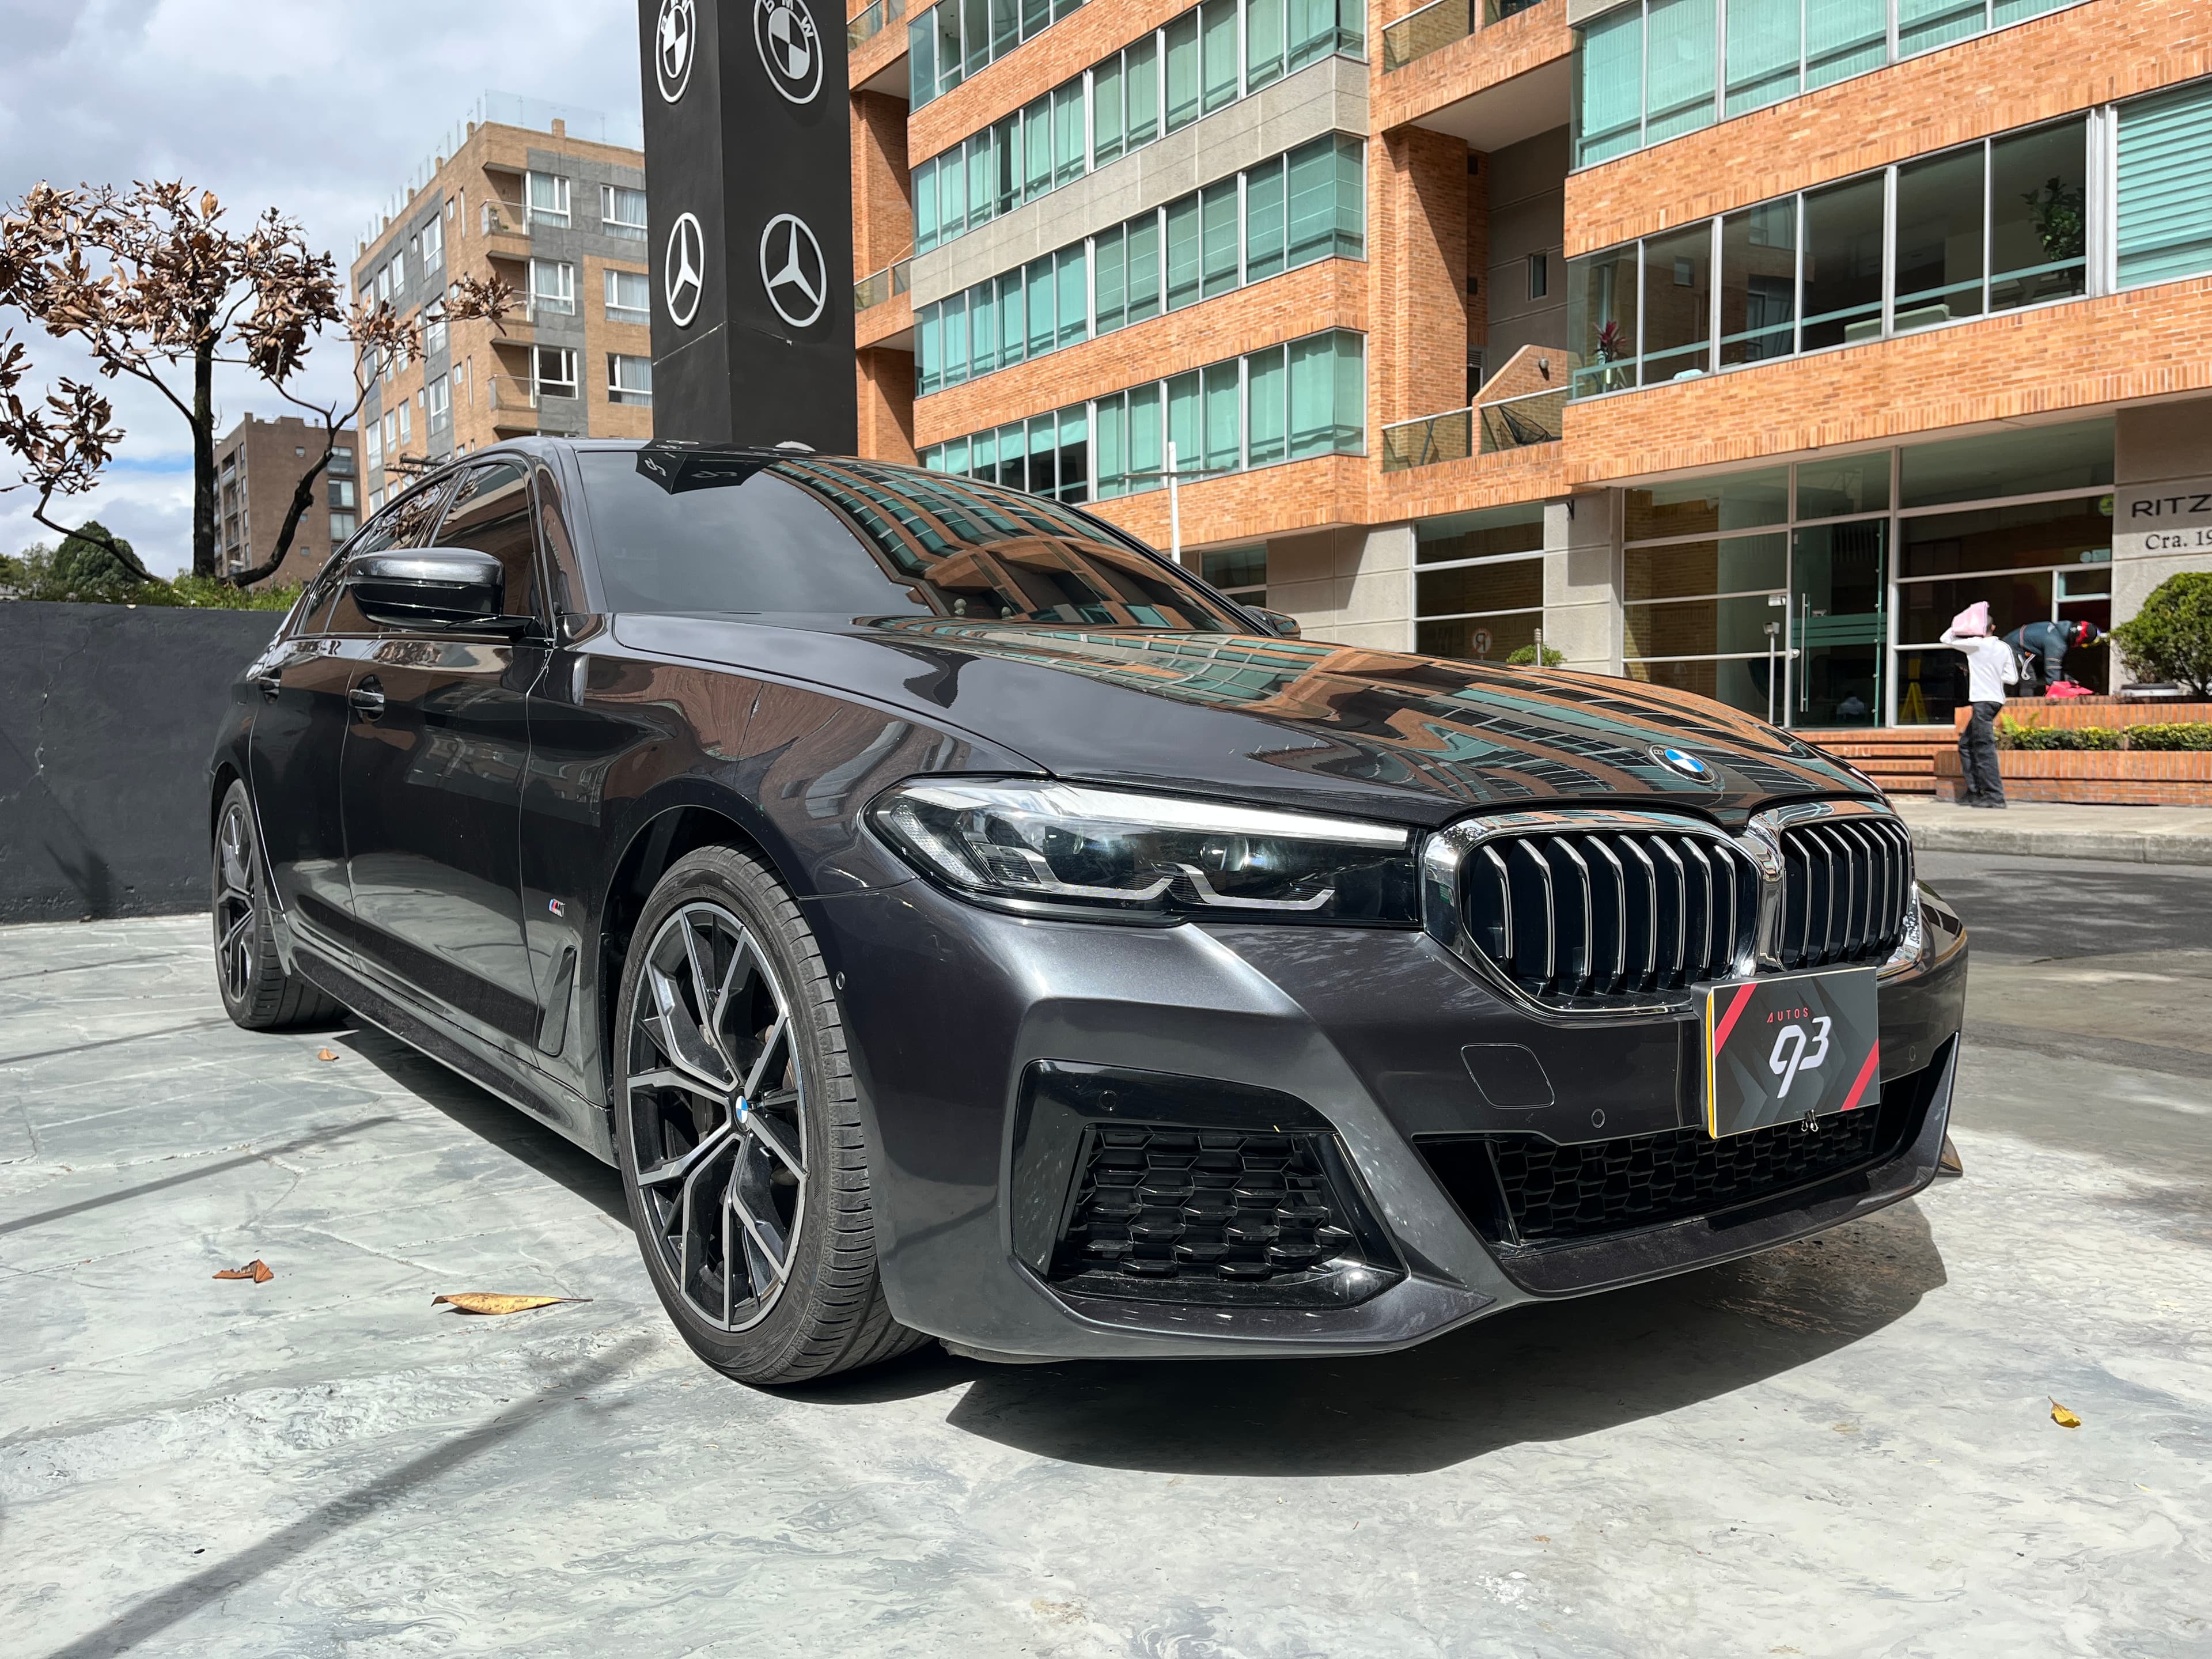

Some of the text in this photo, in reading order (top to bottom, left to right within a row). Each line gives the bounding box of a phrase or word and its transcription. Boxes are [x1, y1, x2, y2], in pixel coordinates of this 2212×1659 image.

[2132, 494, 2212, 518] RITZ
[2146, 534, 2187, 550] Cra.
[1767, 1007, 1809, 1023] AUTOS
[1769, 1016, 1831, 1099] 93
[790, 1213, 818, 1308] YOKOHAMA
